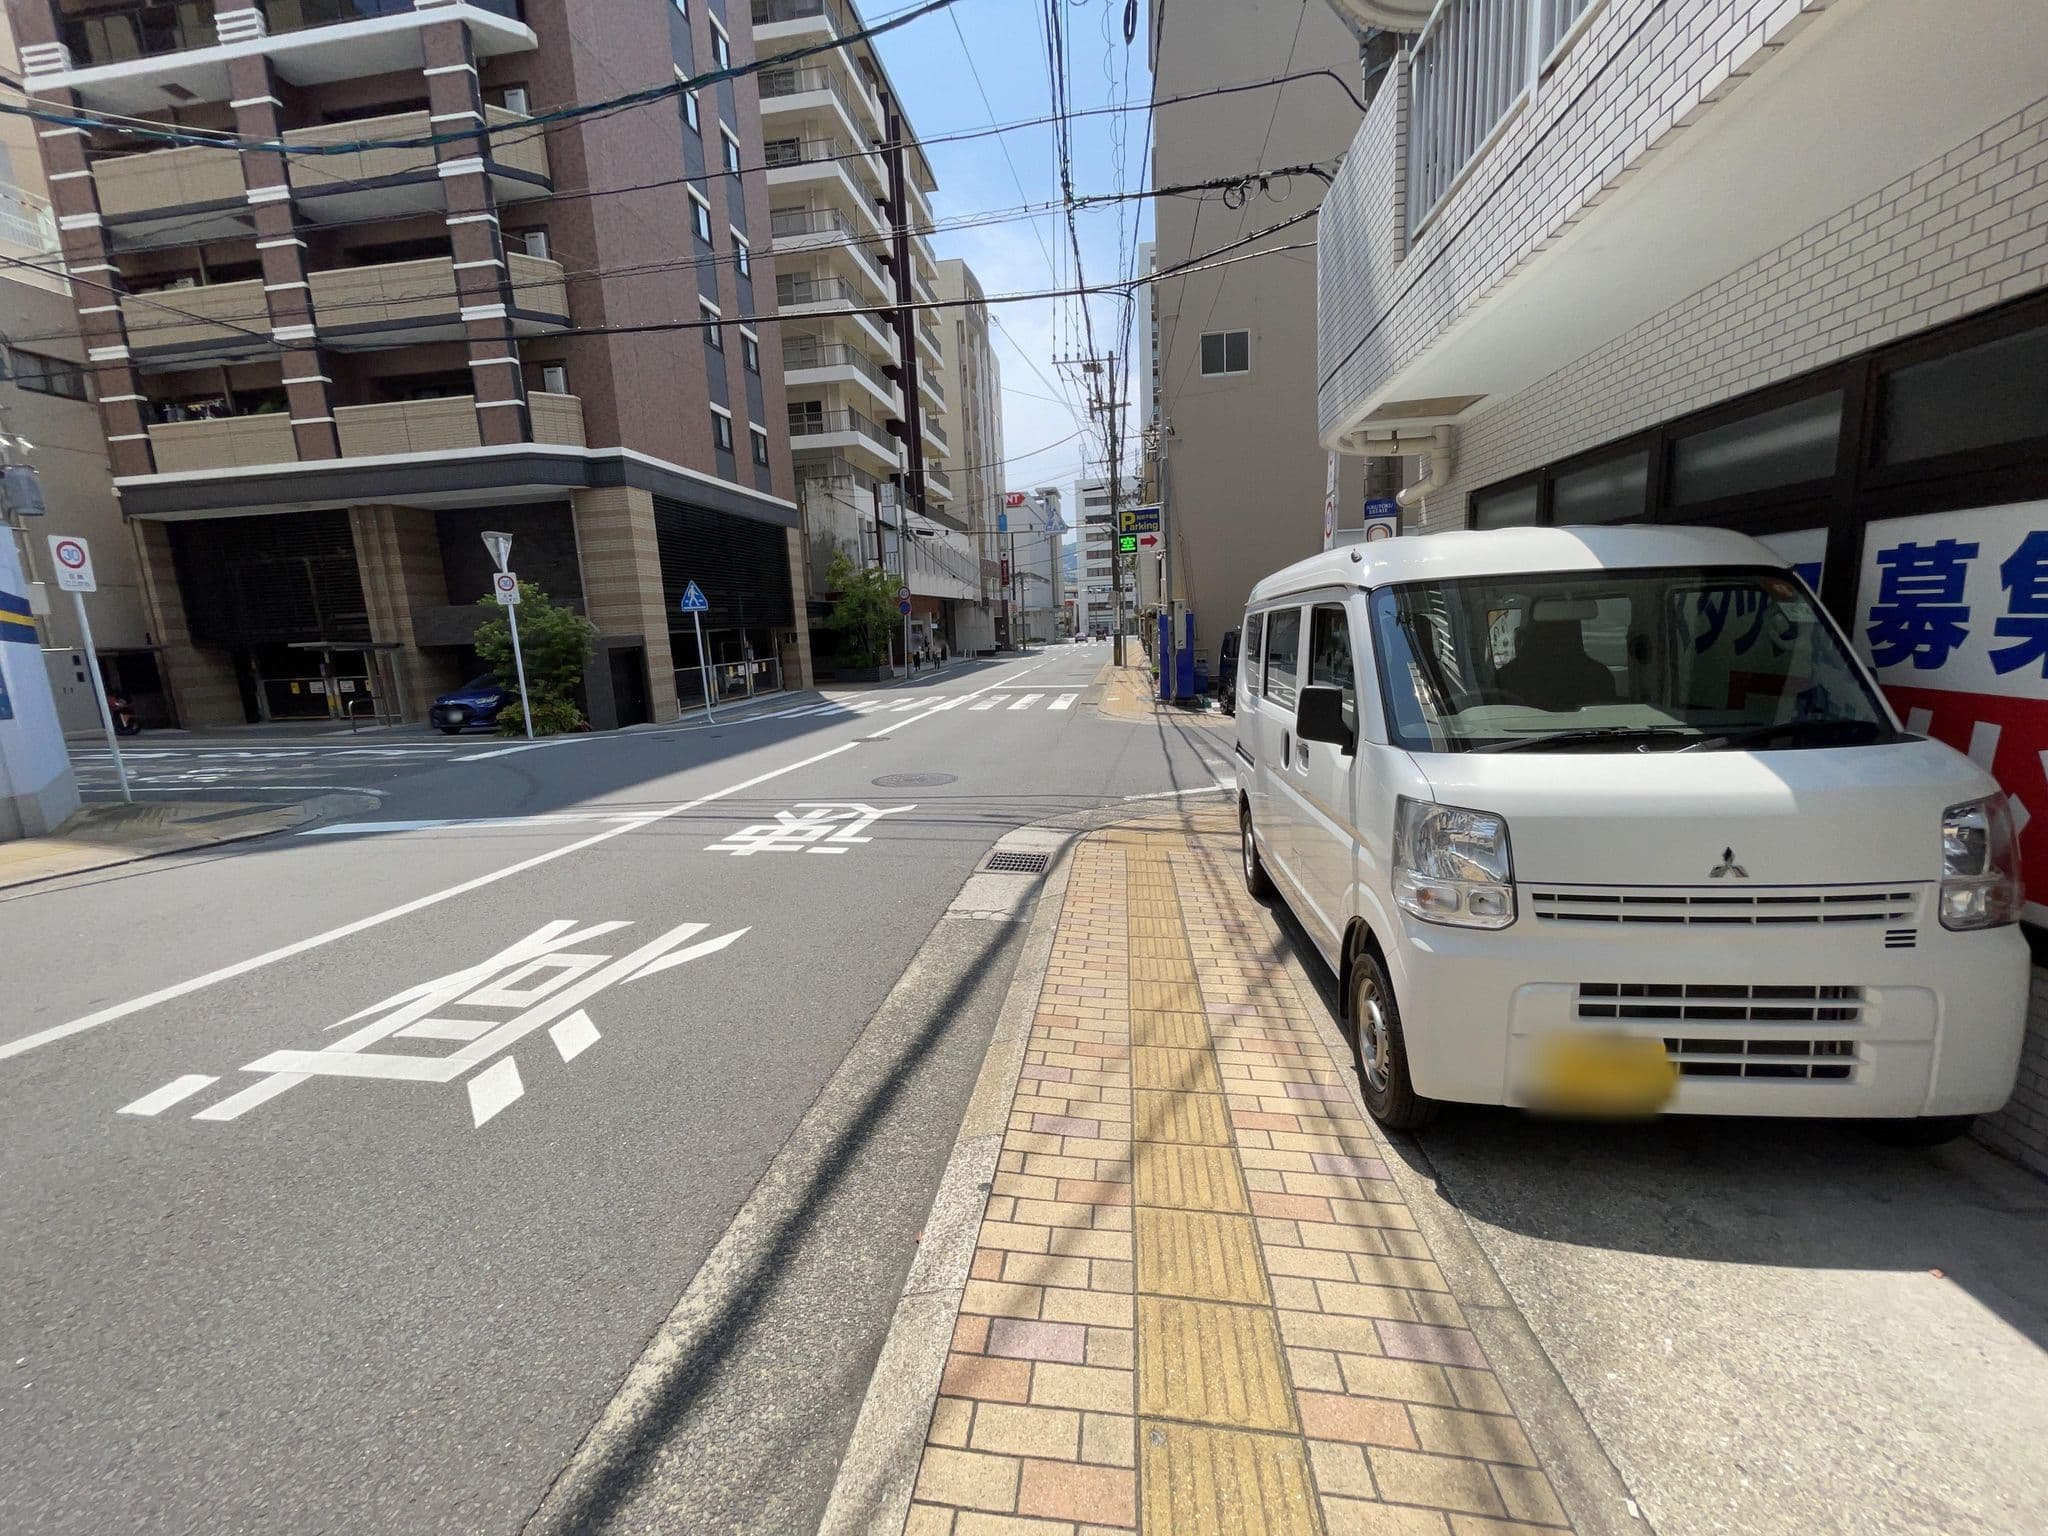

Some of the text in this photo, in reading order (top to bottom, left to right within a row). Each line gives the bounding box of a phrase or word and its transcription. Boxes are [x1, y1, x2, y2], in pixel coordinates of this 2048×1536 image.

[1120, 512, 1159, 532] Parking
[1120, 536, 1136, 551] 空
[63, 548, 80, 562] 30
